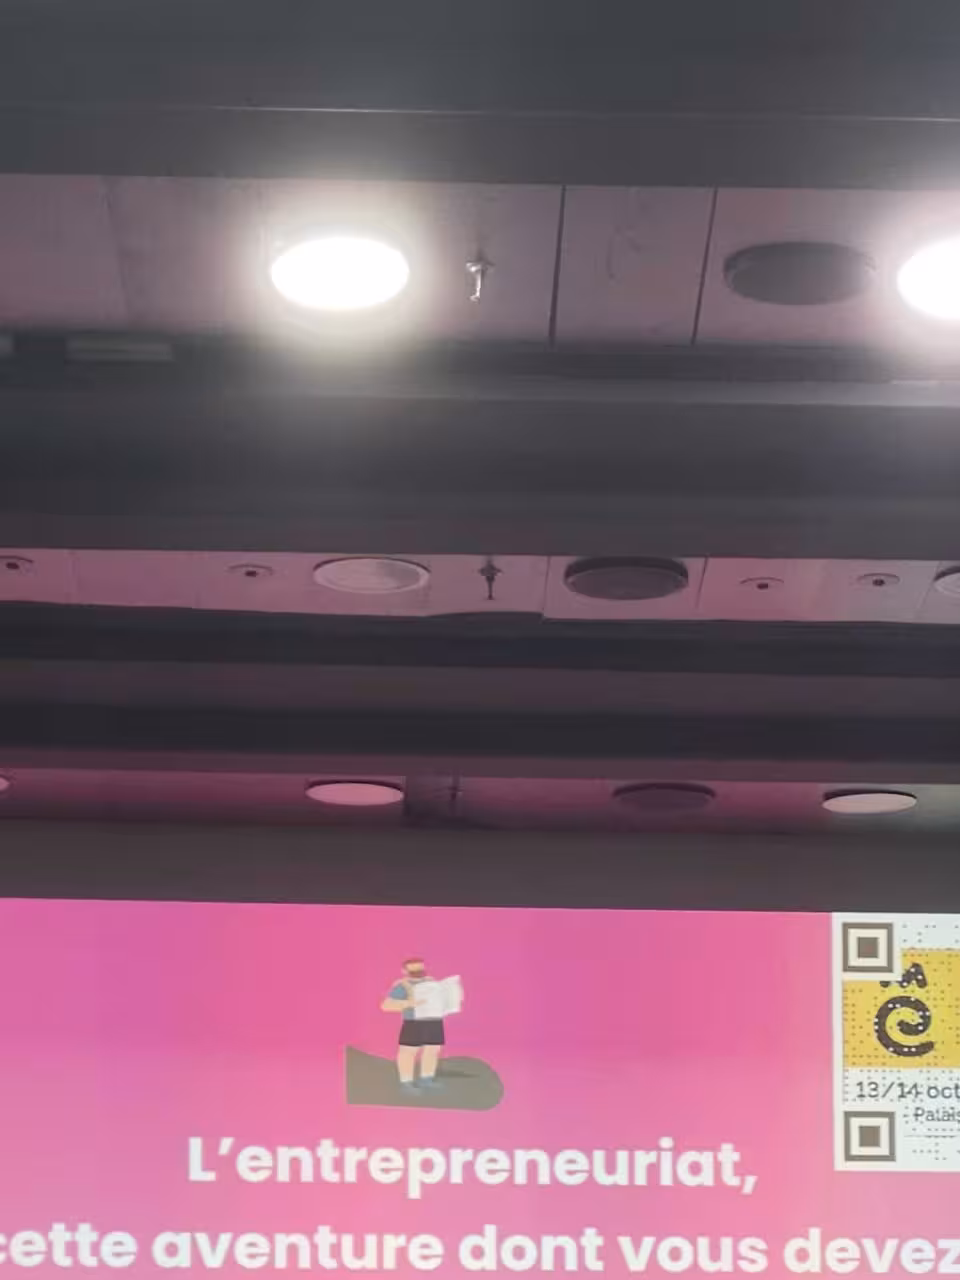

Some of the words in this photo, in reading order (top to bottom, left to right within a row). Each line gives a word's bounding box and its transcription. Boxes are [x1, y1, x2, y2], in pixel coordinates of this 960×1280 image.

[856, 1081, 922, 1098] 13/14
[0, 1223, 138, 1268] ette
[152, 1225, 444, 1271] aventure
[459, 1224, 604, 1272] dont
[617, 1235, 768, 1273] vous
